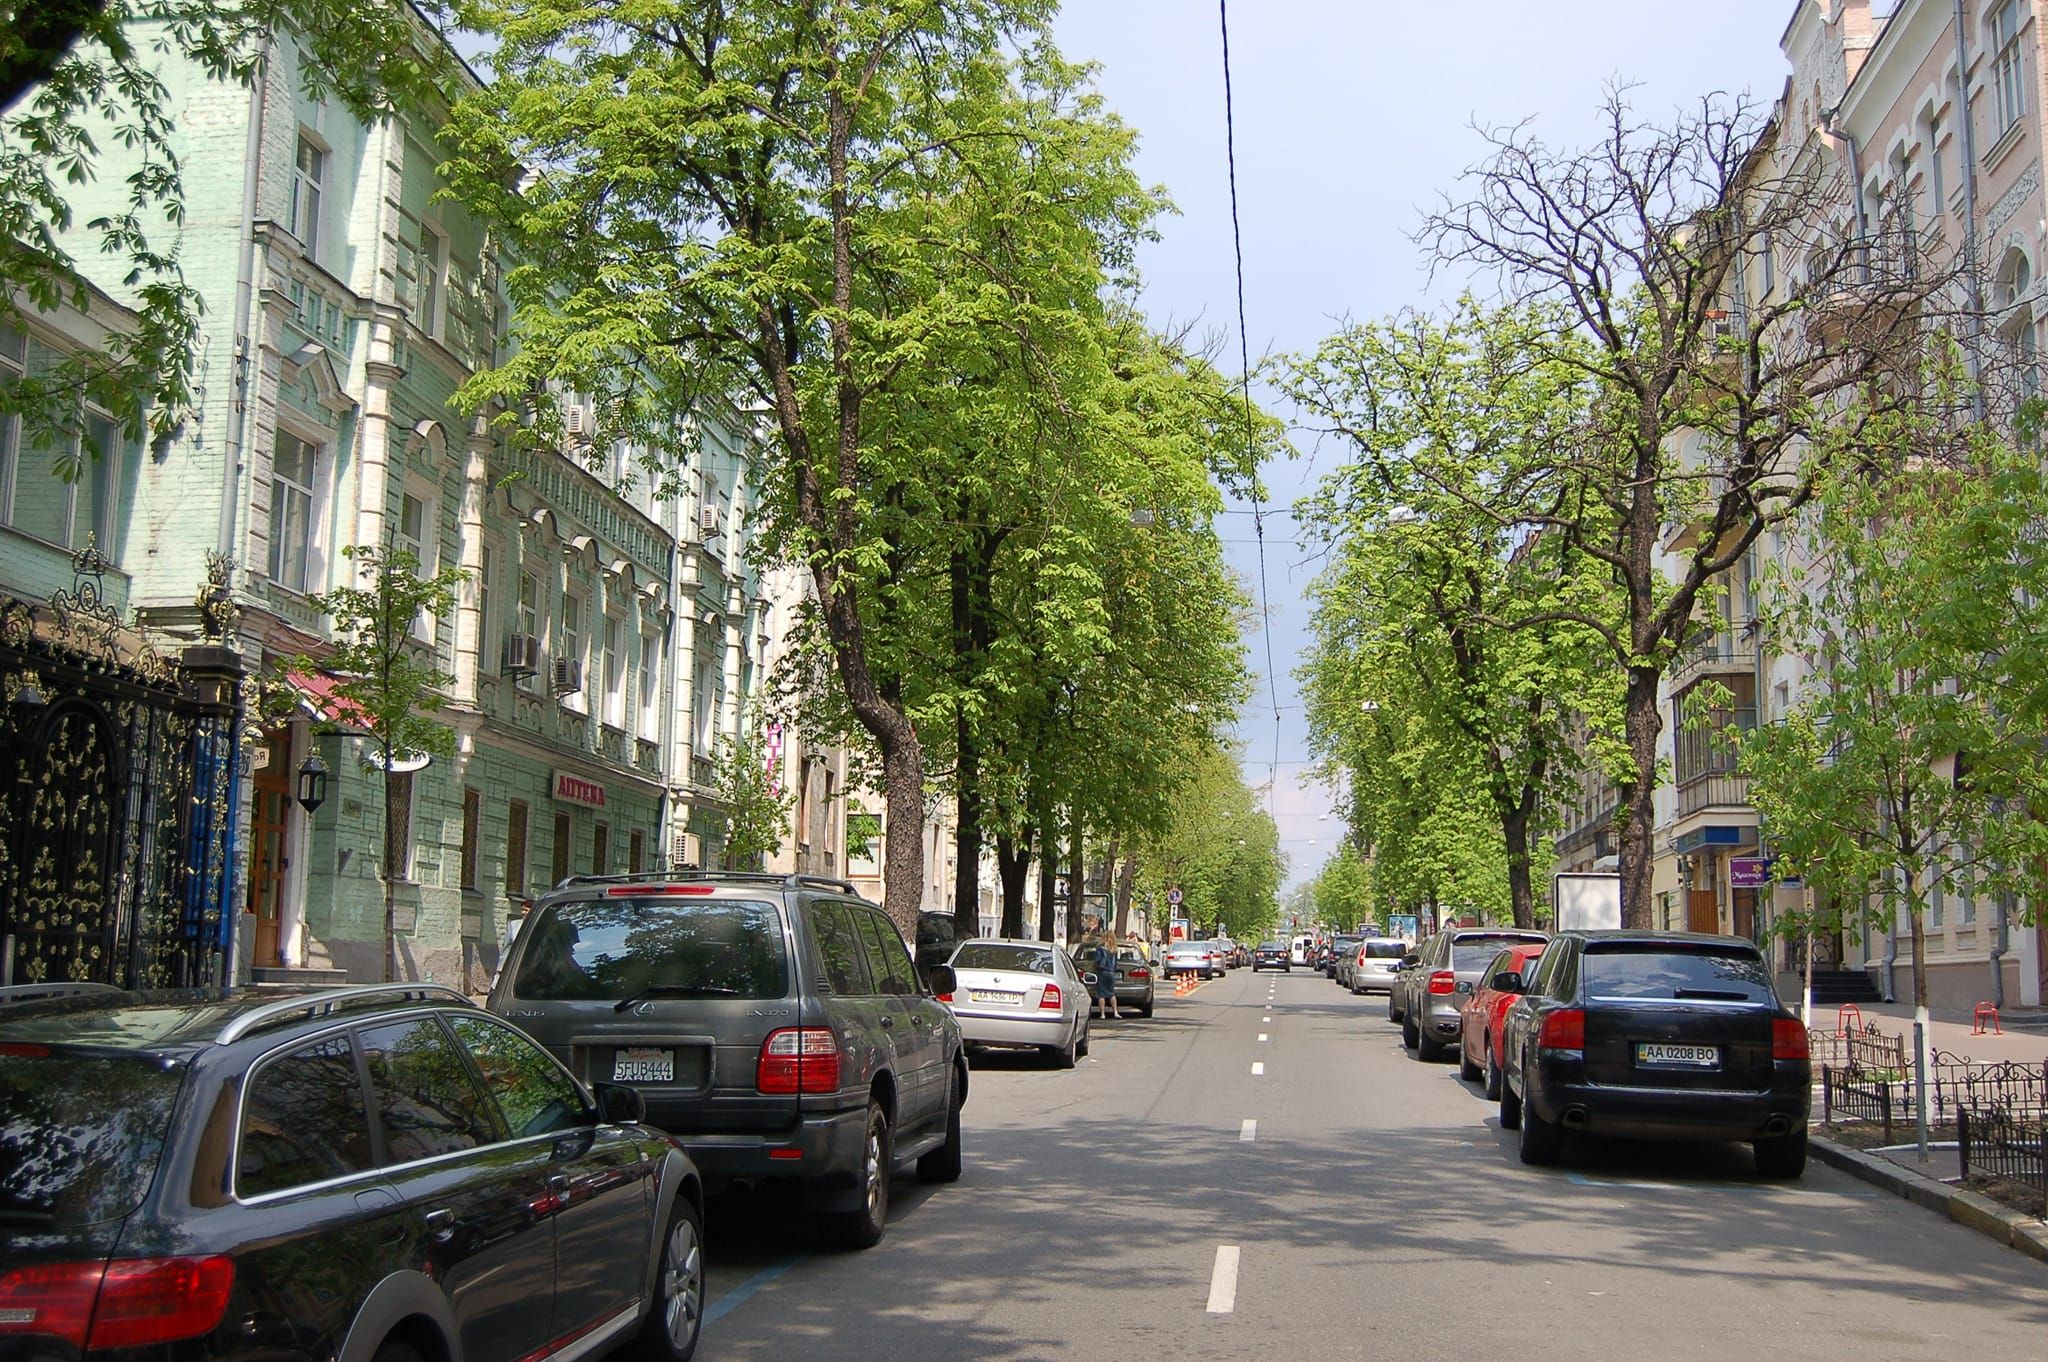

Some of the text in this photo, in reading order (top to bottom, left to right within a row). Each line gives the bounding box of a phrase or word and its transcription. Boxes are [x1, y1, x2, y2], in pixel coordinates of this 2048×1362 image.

[558, 775, 606, 808] АПТЕКА
[1647, 1046, 1714, 1061] AA 0208 BO
[617, 1061, 671, 1077] 5FUB444
